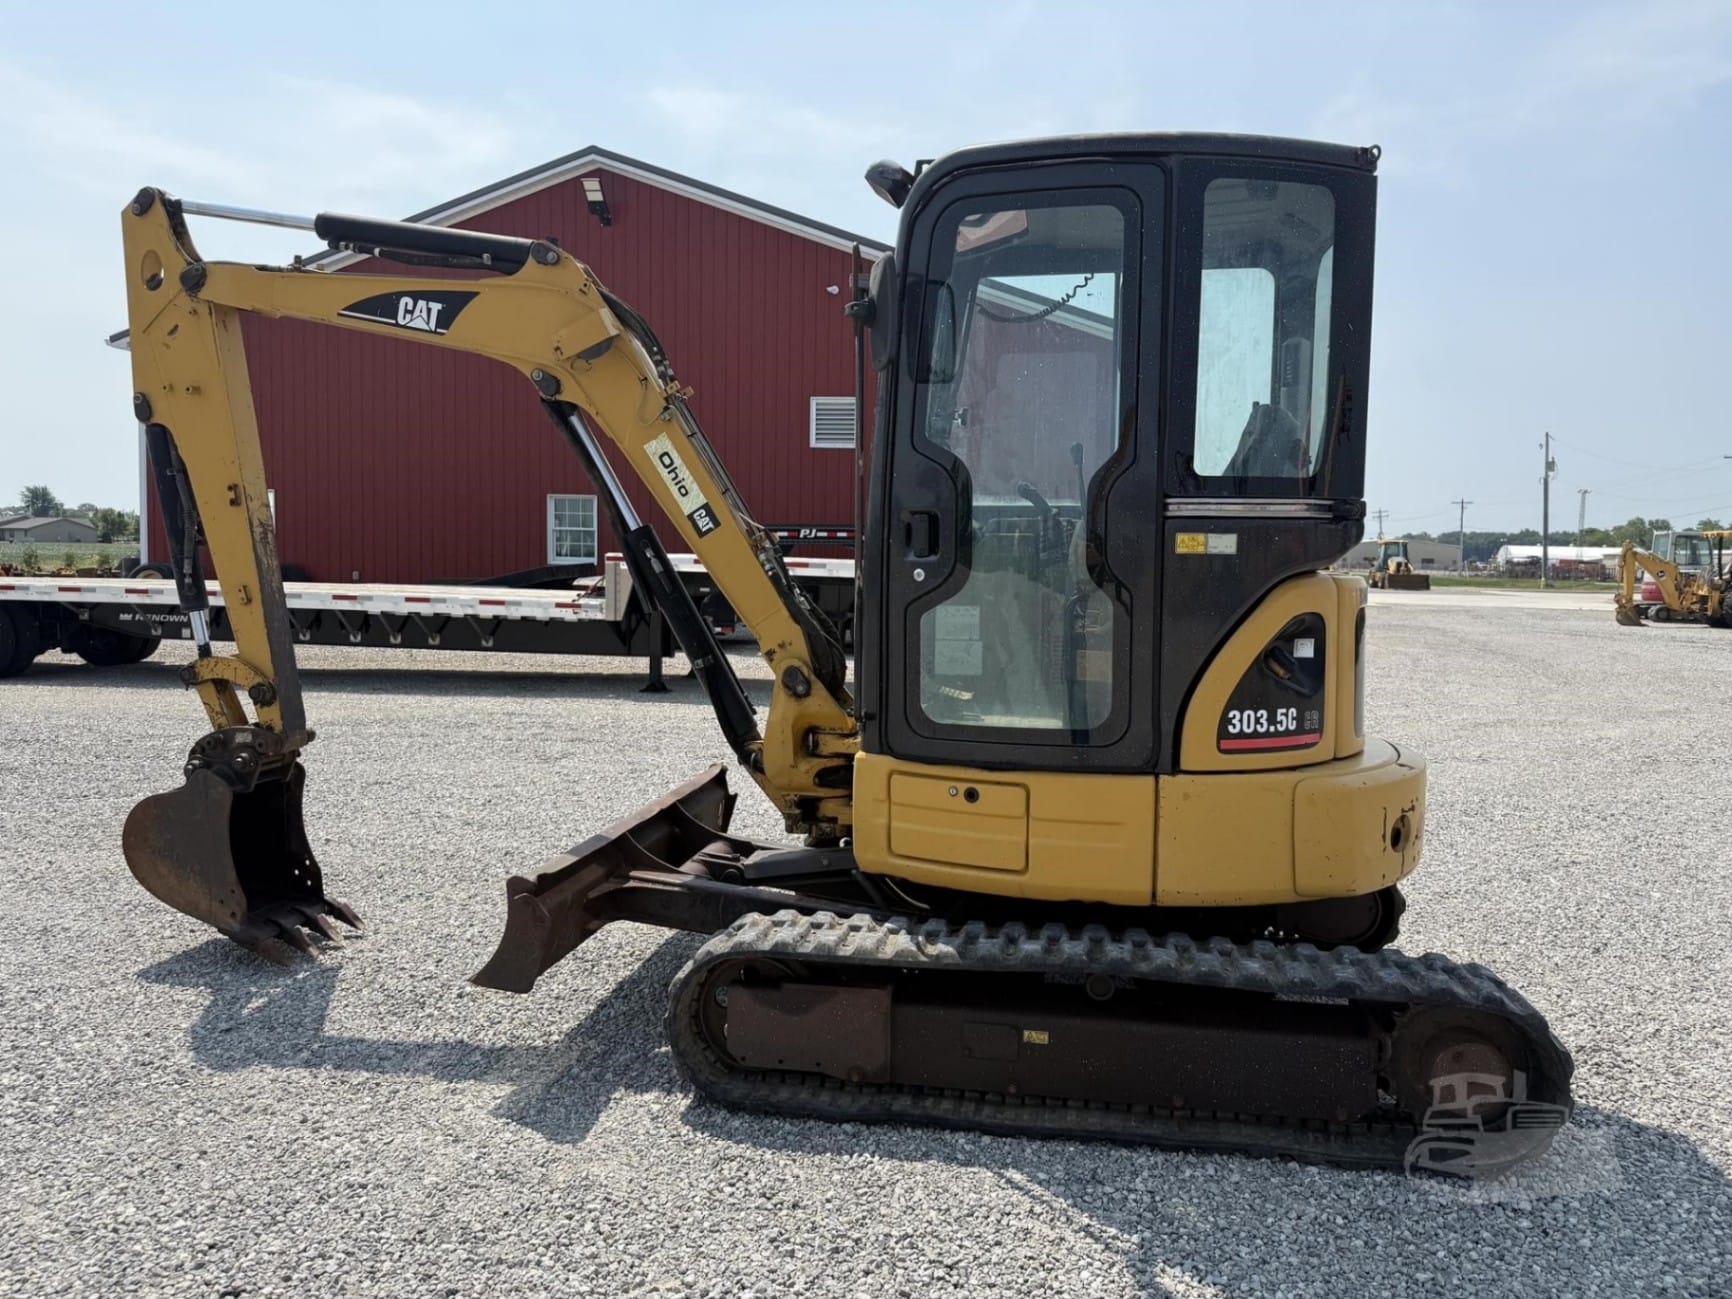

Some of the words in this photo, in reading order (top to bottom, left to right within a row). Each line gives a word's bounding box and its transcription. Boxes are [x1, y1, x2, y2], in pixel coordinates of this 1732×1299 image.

[397, 296, 442, 332] CAT
[659, 451, 689, 498] Ohio
[693, 508, 714, 533] CAT
[799, 528, 817, 539] PJ
[1227, 708, 1297, 734] 303.5C
